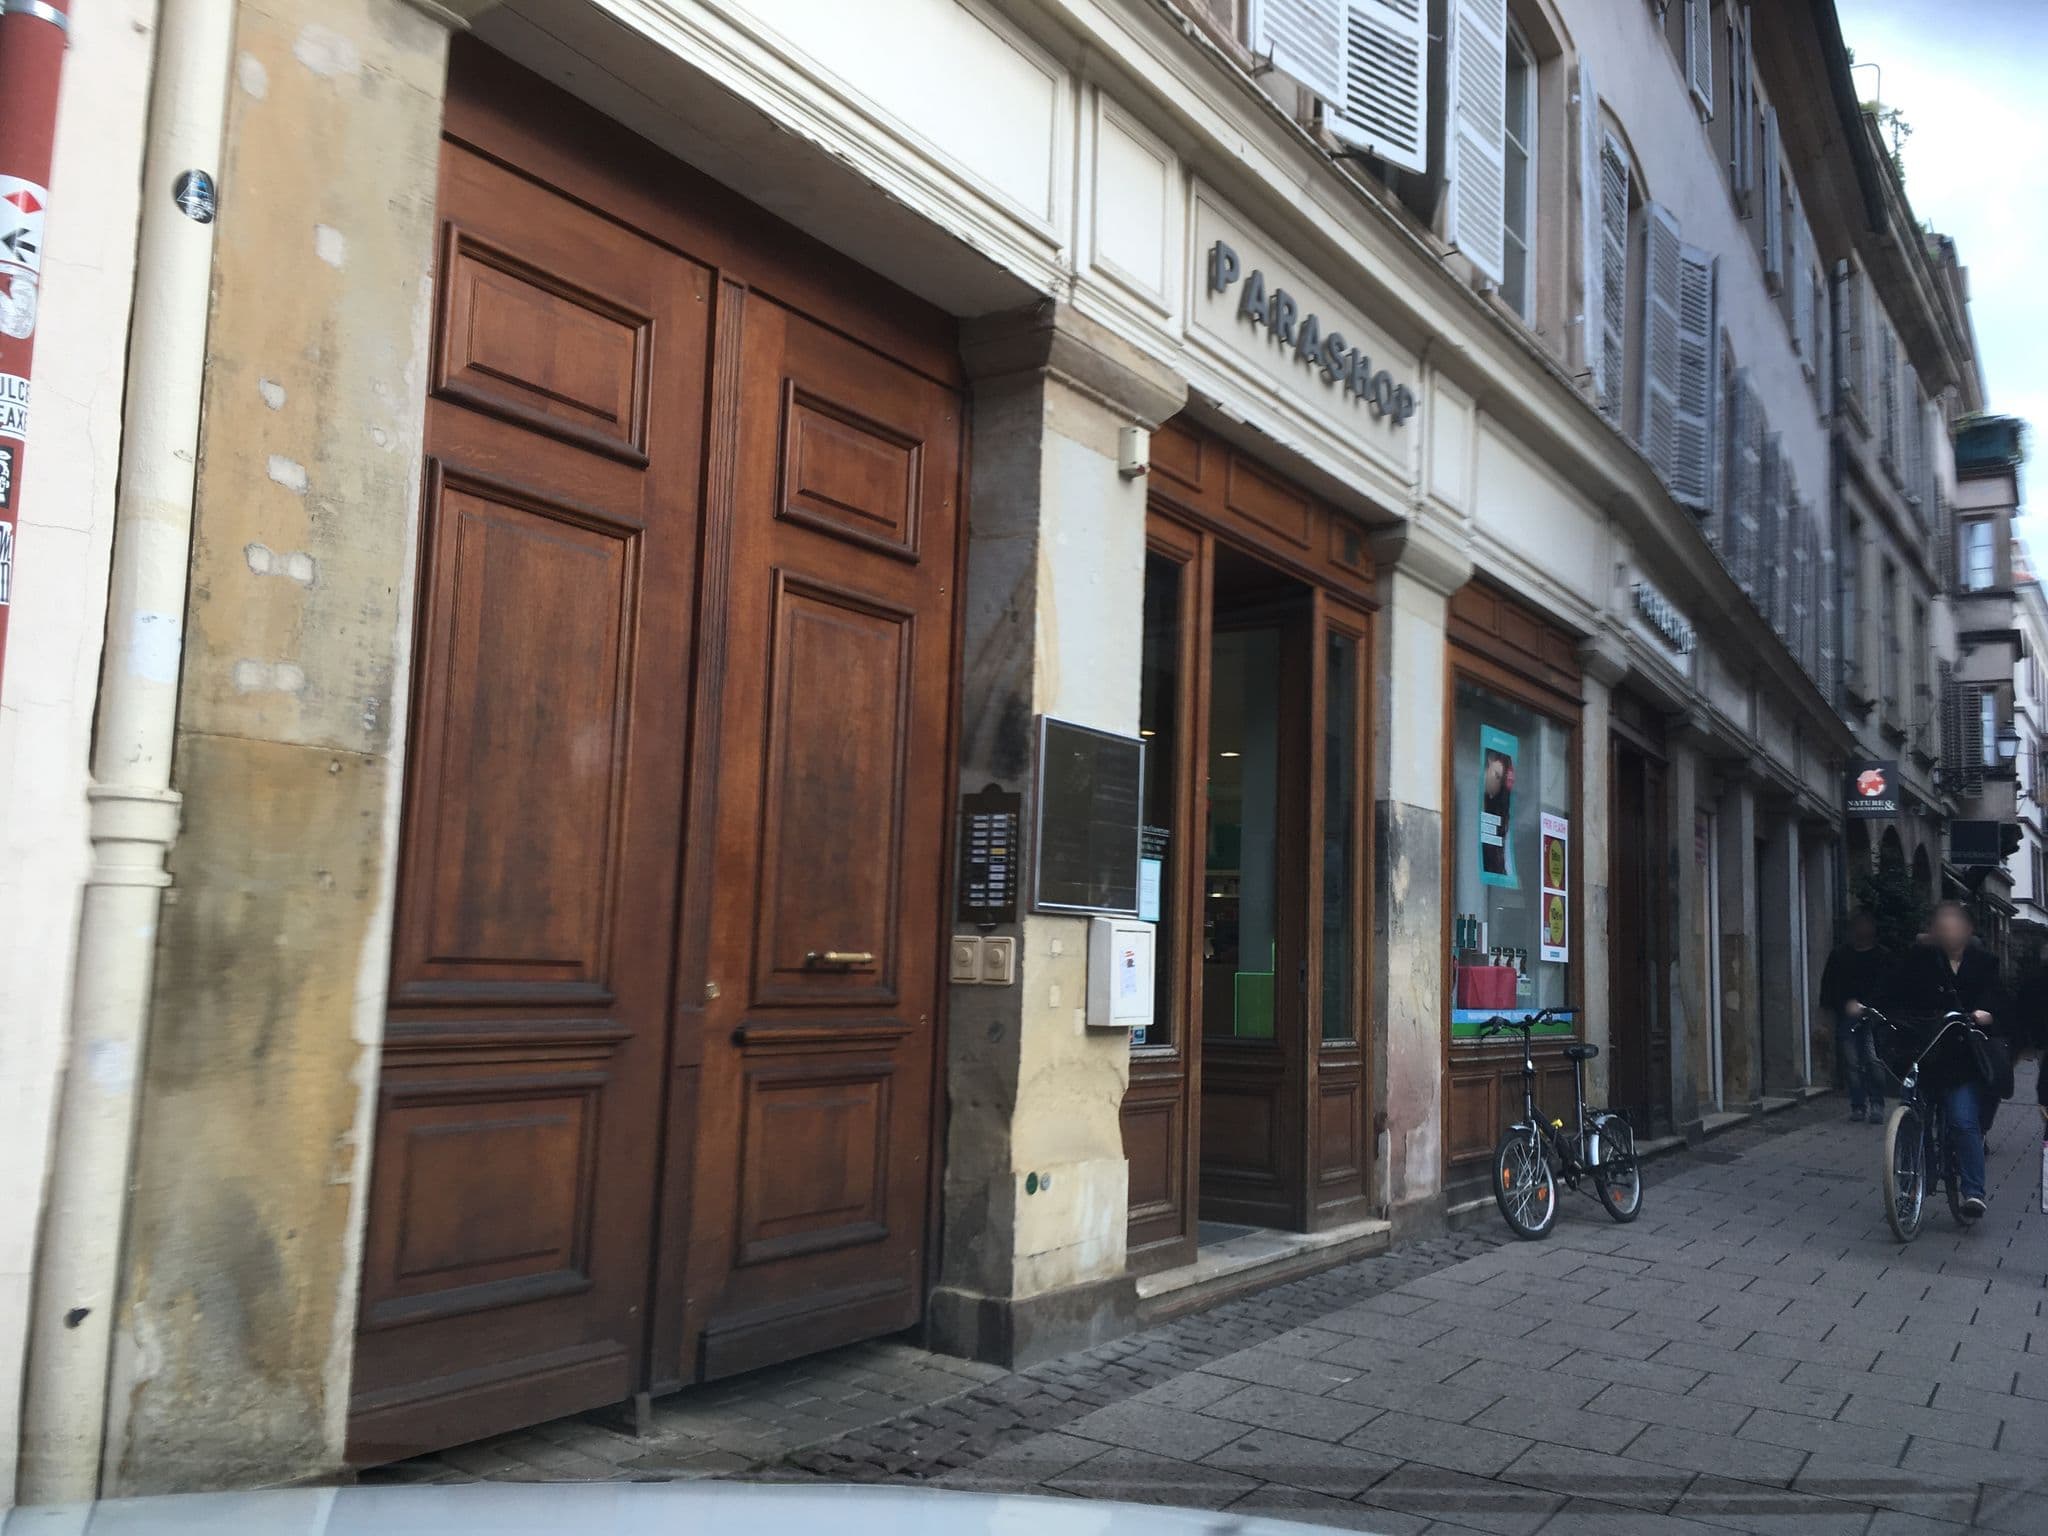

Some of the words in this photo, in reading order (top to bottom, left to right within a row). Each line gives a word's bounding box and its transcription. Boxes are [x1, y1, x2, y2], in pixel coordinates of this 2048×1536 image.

[1212, 240, 1415, 426] PARASHOP
[1847, 799, 1885, 807] NATURE
[1885, 799, 1897, 811] &
